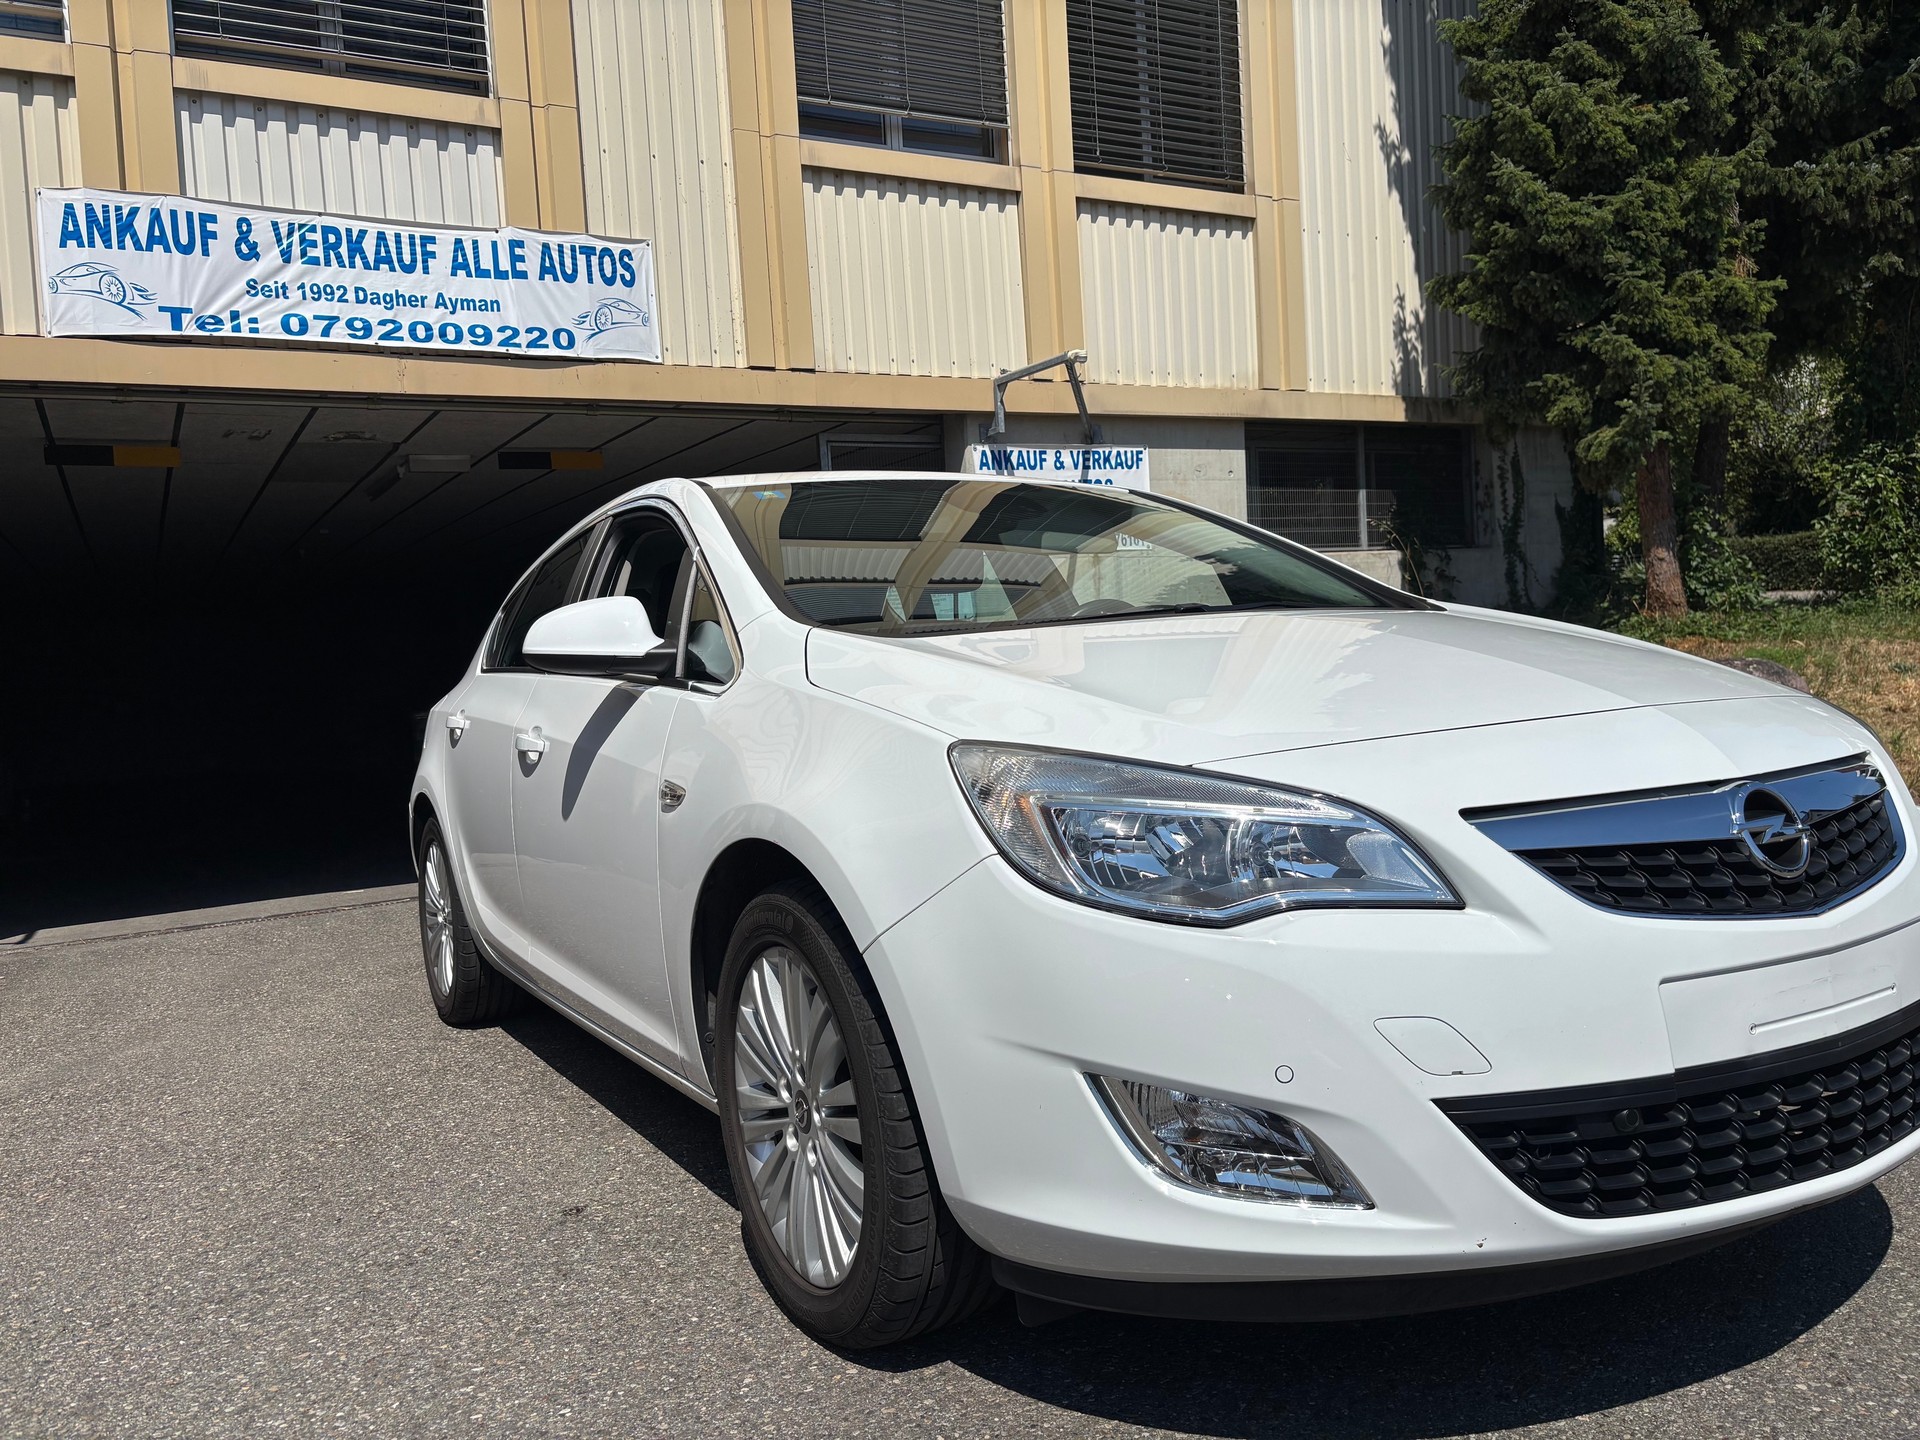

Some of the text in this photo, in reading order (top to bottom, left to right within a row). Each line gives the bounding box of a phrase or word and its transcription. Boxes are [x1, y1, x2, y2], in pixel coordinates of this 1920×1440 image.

[59, 202, 636, 289] ANKAUF & VERKAUF ALLE AUTOS
[245, 278, 501, 315] Seit 1992 Dagher Ayman
[157, 305, 576, 351] Tel: 0792009220
[979, 449, 1143, 471] ANKAUF & VERKAUF
